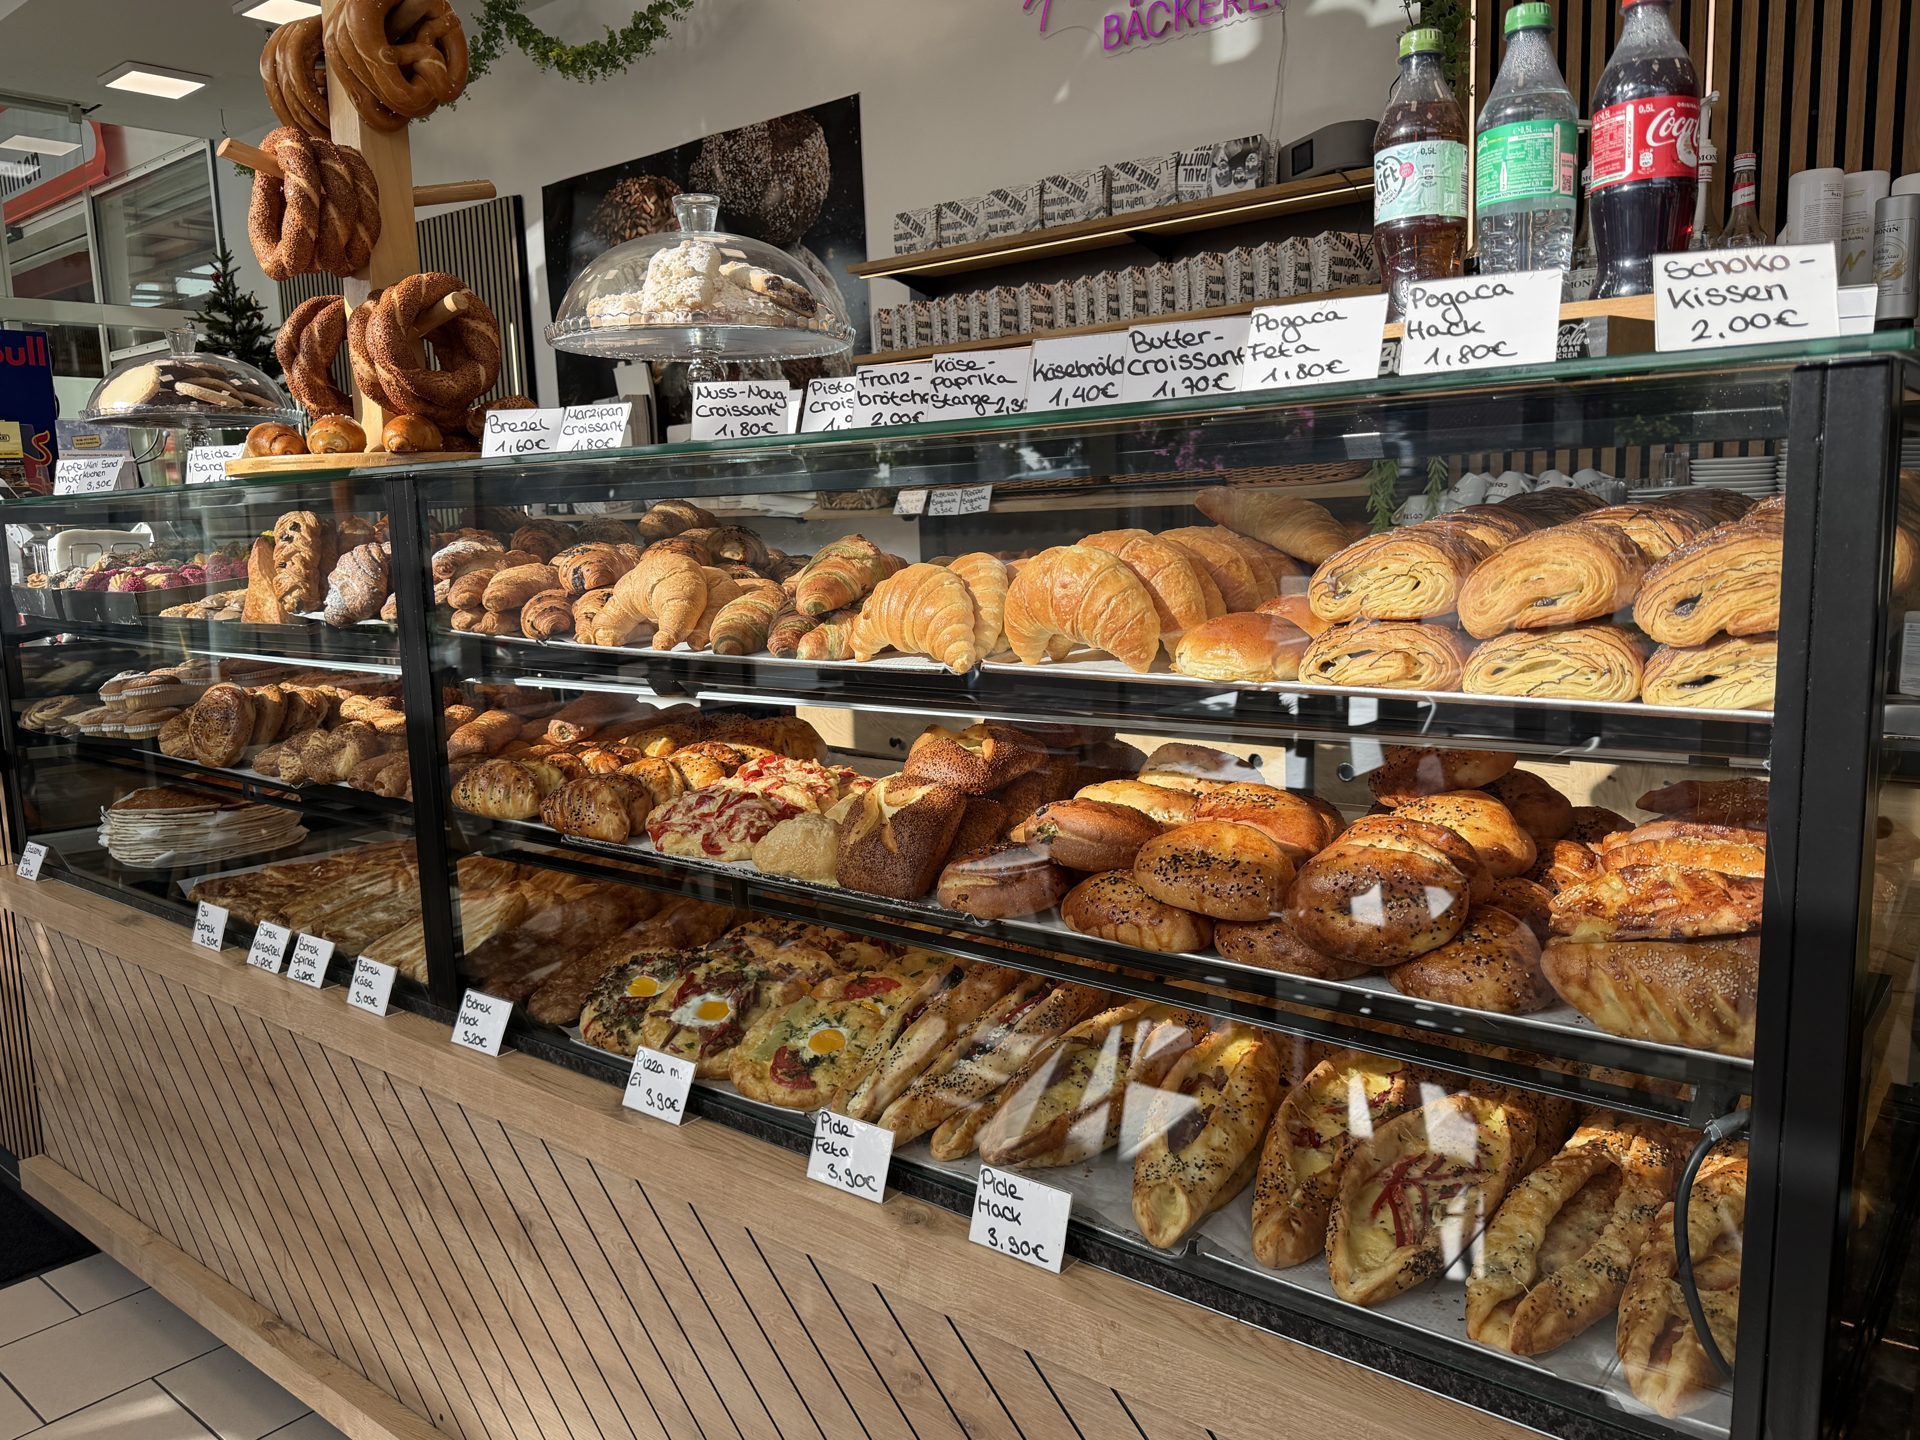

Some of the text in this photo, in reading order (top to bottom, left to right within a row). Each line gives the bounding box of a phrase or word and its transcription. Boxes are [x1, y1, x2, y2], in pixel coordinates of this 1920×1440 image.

[1639, 104, 1655, 114] 0,5L
[1420, 147, 1437, 156] 0,5L
[1183, 168, 1209, 183] PAUL
[1664, 254, 1815, 280] Schoko-
[1409, 283, 1514, 324] Pogaca
[1250, 311, 1347, 343] Pogaca
[1407, 320, 1485, 341] Hack
[0, 335, 47, 366] ull
[1129, 329, 1224, 353] Butter-
[1248, 342, 1320, 361] Feta
[1424, 341, 1518, 366] 1,80€
[857, 369, 922, 387] Franz-
[1261, 360, 1350, 383] 1,80€
[1049, 382, 1119, 406] 1,40€
[1152, 373, 1236, 398] 1,70€
[565, 406, 624, 421] Marzipan
[871, 410, 925, 427] 2,00€
[487, 414, 550, 434] Brezel
[715, 421, 779, 438] 1,80€
[195, 449, 236, 461] Heide-
[495, 439, 550, 453] 1,60€
[570, 437, 617, 453] 1,80€
[196, 919, 216, 935] Börek
[260, 923, 277, 940] Börek
[299, 936, 319, 956] Börek
[293, 953, 316, 969] Spinat
[358, 960, 381, 976] Börek
[466, 994, 492, 1015] Börek
[460, 1010, 479, 1027] Hack
[637, 1049, 665, 1075] Pizza
[629, 1072, 642, 1087] Ei
[646, 1088, 681, 1112] 3,90€
[820, 1111, 855, 1138] Pide
[813, 1136, 851, 1158] Feta
[827, 1163, 878, 1192] 3,90€
[981, 1168, 1024, 1201] Pide
[978, 1195, 1021, 1226] Hack
[988, 1227, 1049, 1263] 3,90€
